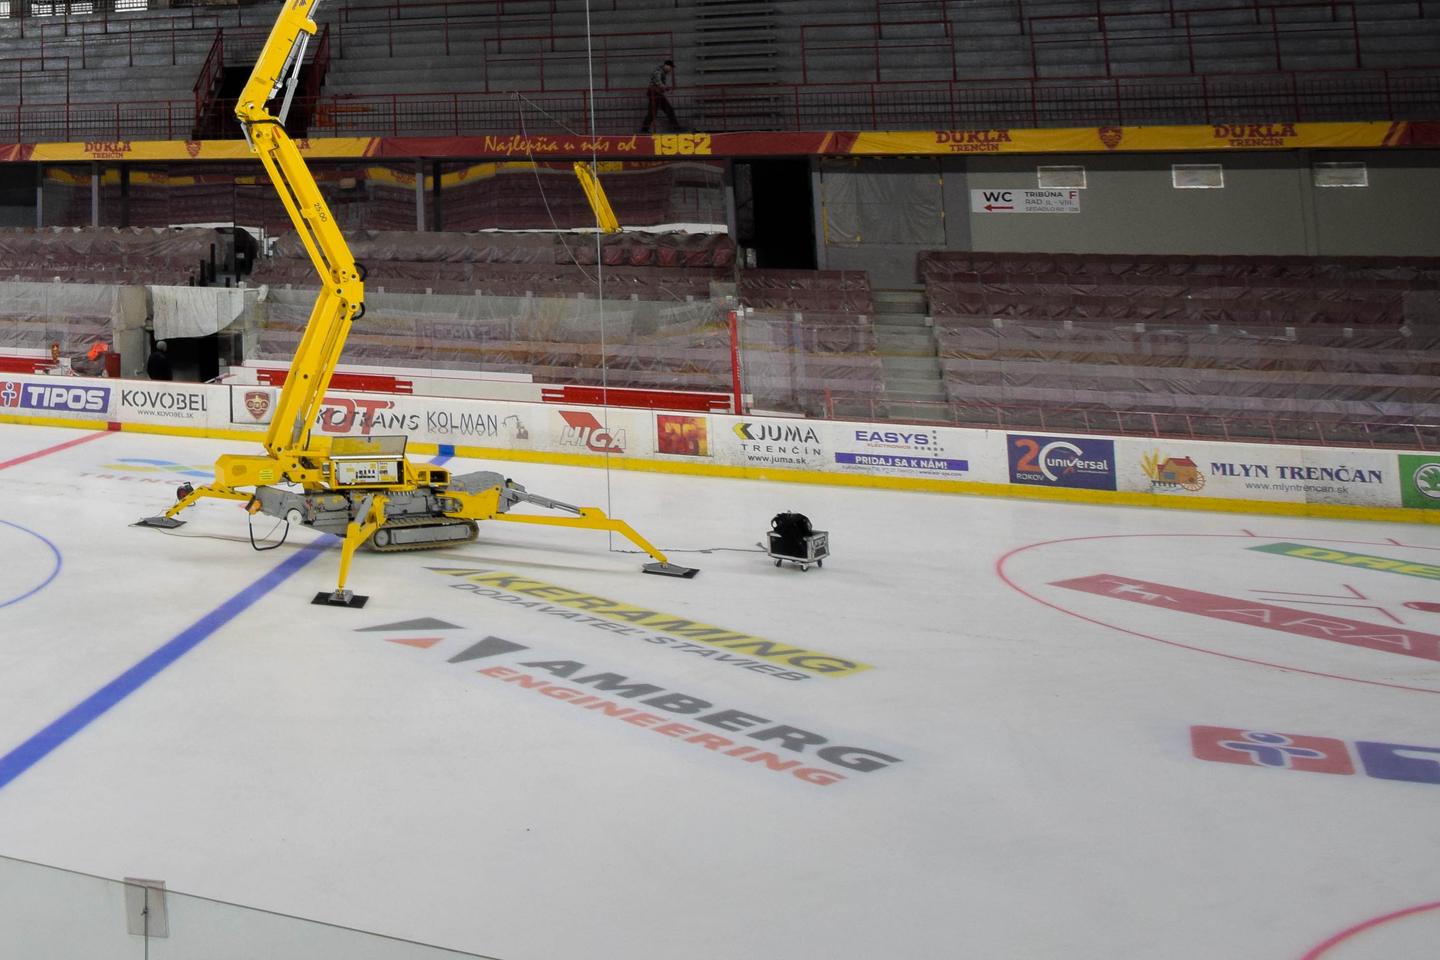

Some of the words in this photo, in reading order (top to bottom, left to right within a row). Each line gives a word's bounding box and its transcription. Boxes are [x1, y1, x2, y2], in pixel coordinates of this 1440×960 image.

[935, 129, 1012, 144] DUKLA
[1213, 123, 1298, 138] DUKLA
[83, 142, 131, 153] DUKLA
[484, 135, 559, 155] Najlepšia
[564, 143, 576, 152] u
[581, 139, 609, 152] nás
[617, 136, 637, 151] od
[651, 134, 712, 155] 1962
[983, 191, 1013, 202] WC
[1069, 190, 1077, 199] F
[27, 386, 105, 410] TIPOS
[121, 389, 207, 412] KOVOBEL
[427, 411, 498, 432] KOLMAN
[560, 426, 626, 448] HIGA
[751, 423, 820, 443] JUMA
[855, 431, 928, 445] EASYS
[748, 455, 806, 465] www.juma.sk
[855, 456, 893, 466] PRIDAJ
[895, 458, 908, 467] SA
[910, 459, 918, 468] K
[920, 458, 948, 469] NÁM!
[1047, 457, 1109, 470] universal
[1211, 462, 1270, 479] MLYN
[1275, 464, 1382, 484] TRENČAN
[1246, 482, 1349, 495] www.mlyntrencan.sk
[477, 575, 859, 674] KERAMING
[644, 636, 811, 681] STAVIEB
[477, 666, 849, 787] ENGINEERING
[517, 660, 903, 773] AMBERG
